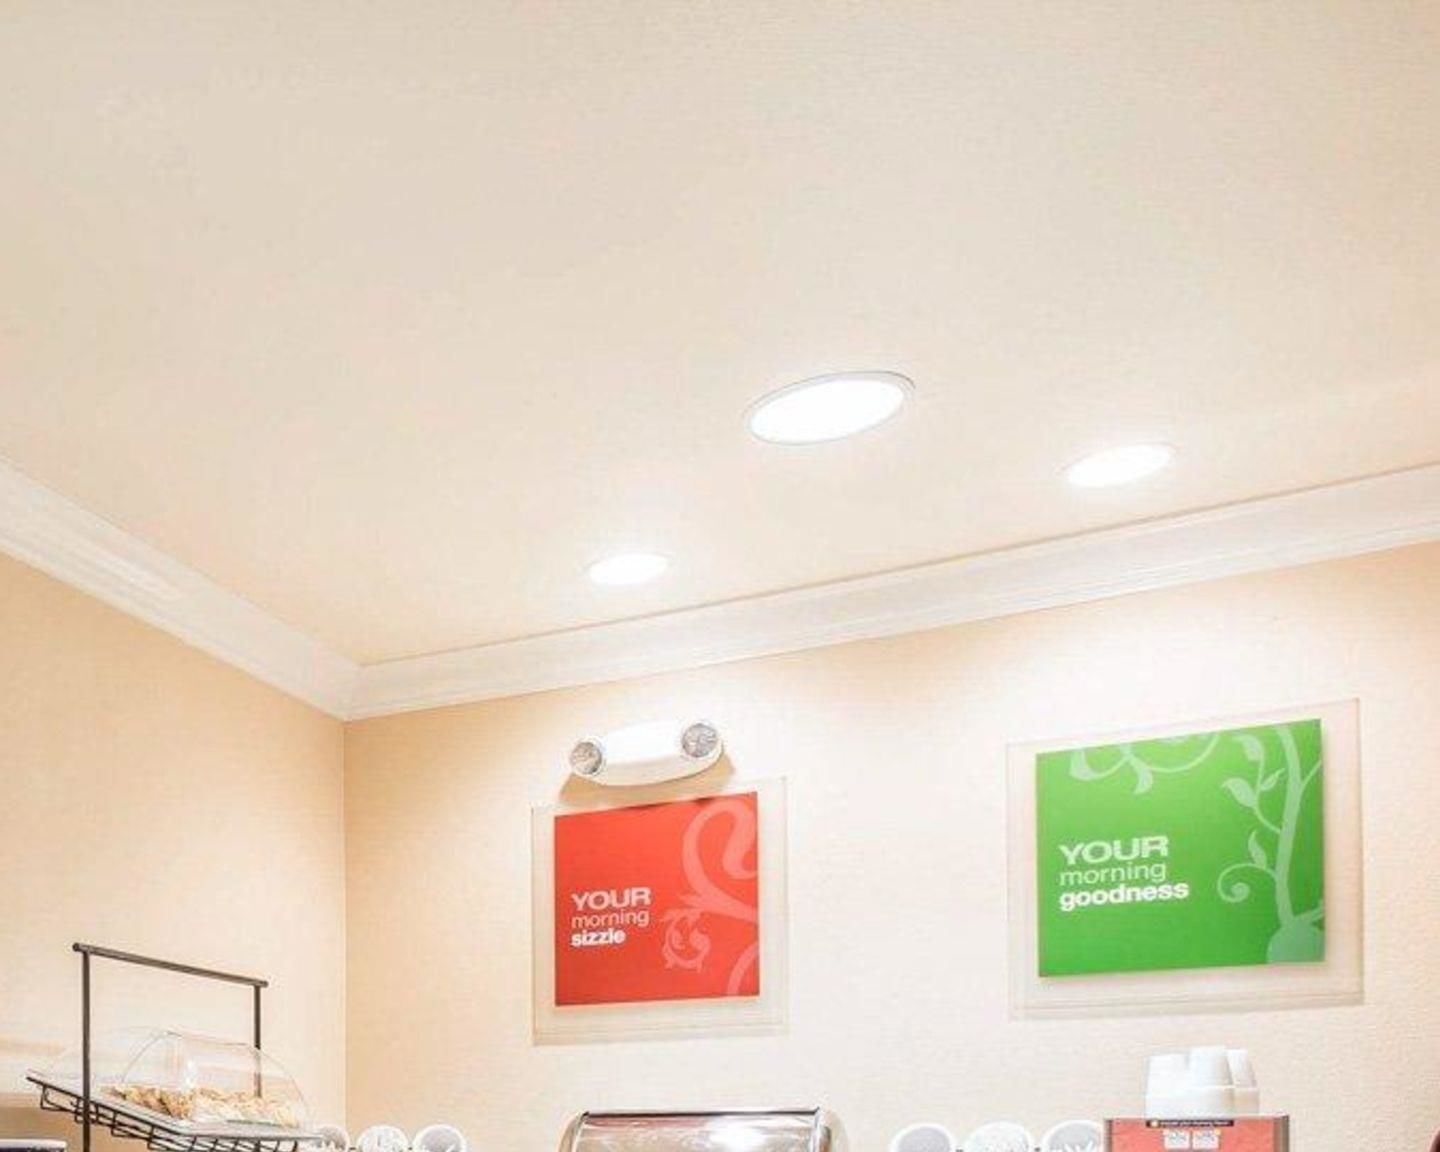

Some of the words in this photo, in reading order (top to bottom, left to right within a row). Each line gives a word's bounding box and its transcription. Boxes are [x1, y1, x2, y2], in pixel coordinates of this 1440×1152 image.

[1059, 835, 1170, 865] YOUR
[1059, 862, 1167, 886] morning
[571, 887, 651, 911] YOUR
[1059, 882, 1190, 912] goodness
[571, 909, 650, 928] morning
[571, 927, 626, 948] sizzle
